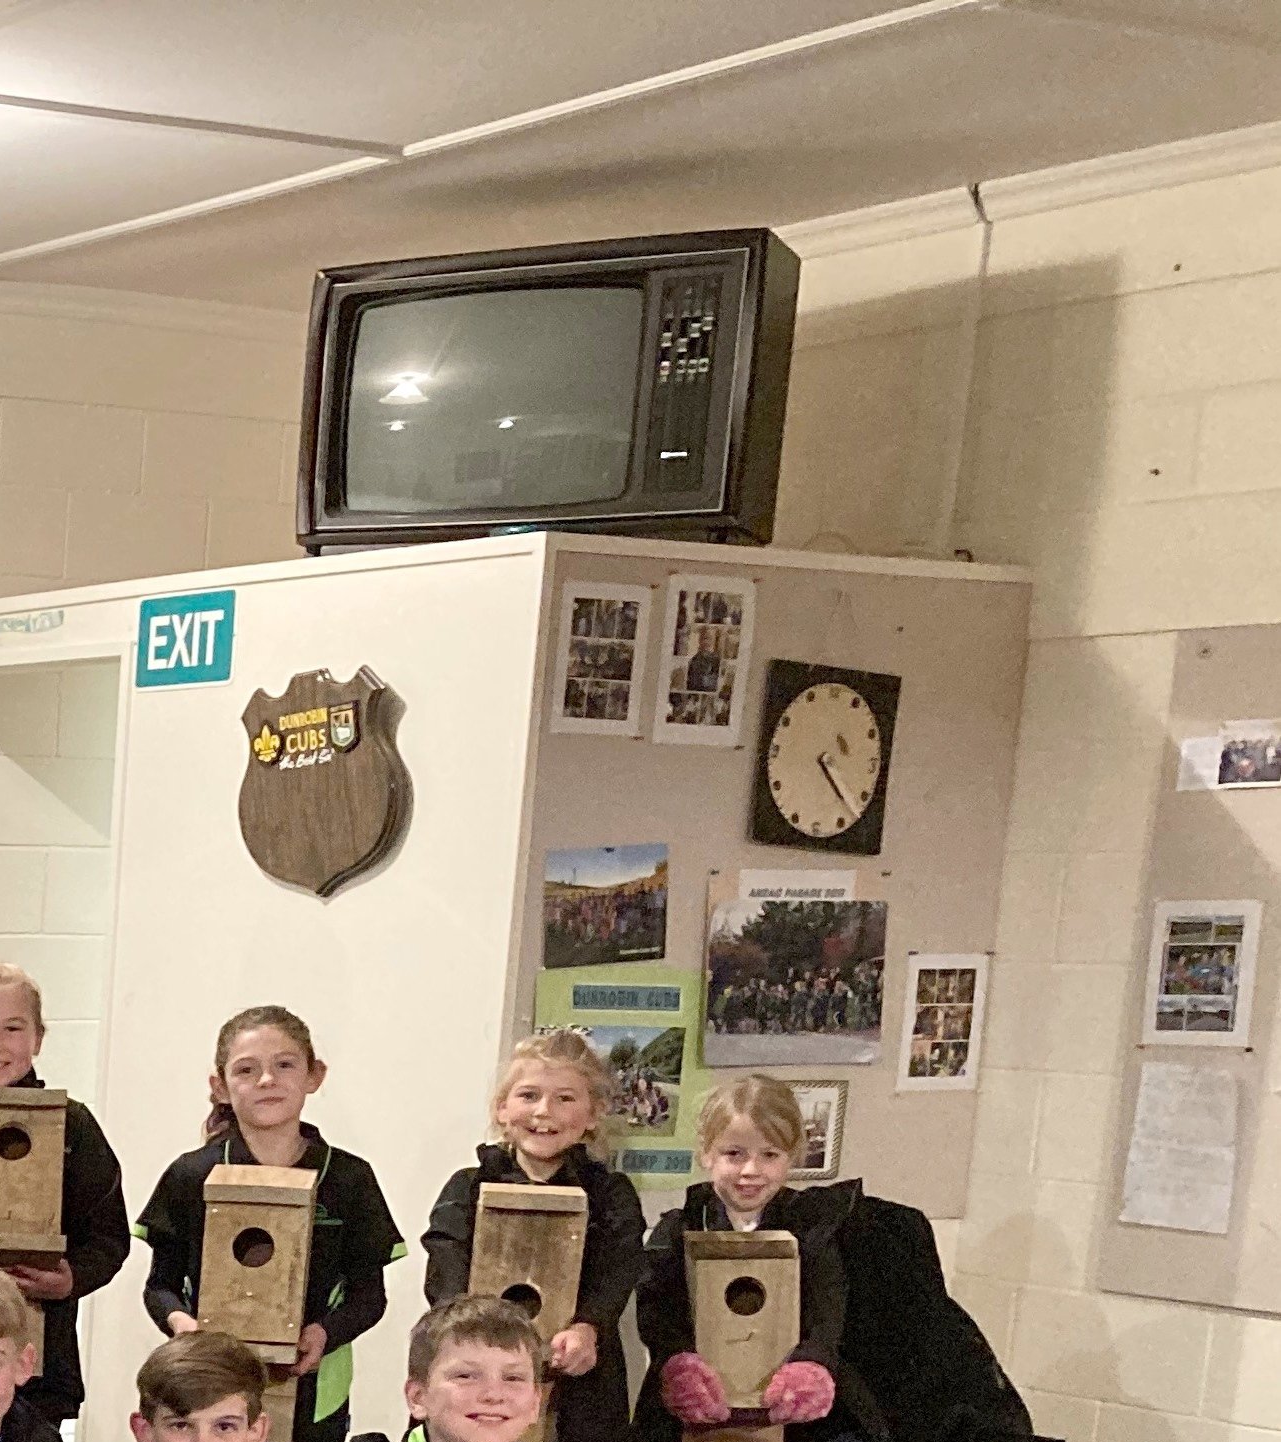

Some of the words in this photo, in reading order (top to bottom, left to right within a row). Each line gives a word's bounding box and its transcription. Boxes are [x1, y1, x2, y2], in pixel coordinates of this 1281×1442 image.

[147, 609, 224, 670] EXIT
[279, 707, 328, 731] DUNROBIN
[286, 729, 326, 753] CUBS
[749, 888, 782, 898] ANZAC
[784, 888, 821, 898] PARADE
[573, 991, 638, 1007] DUNROBIN
[647, 991, 679, 1007] CUBS
